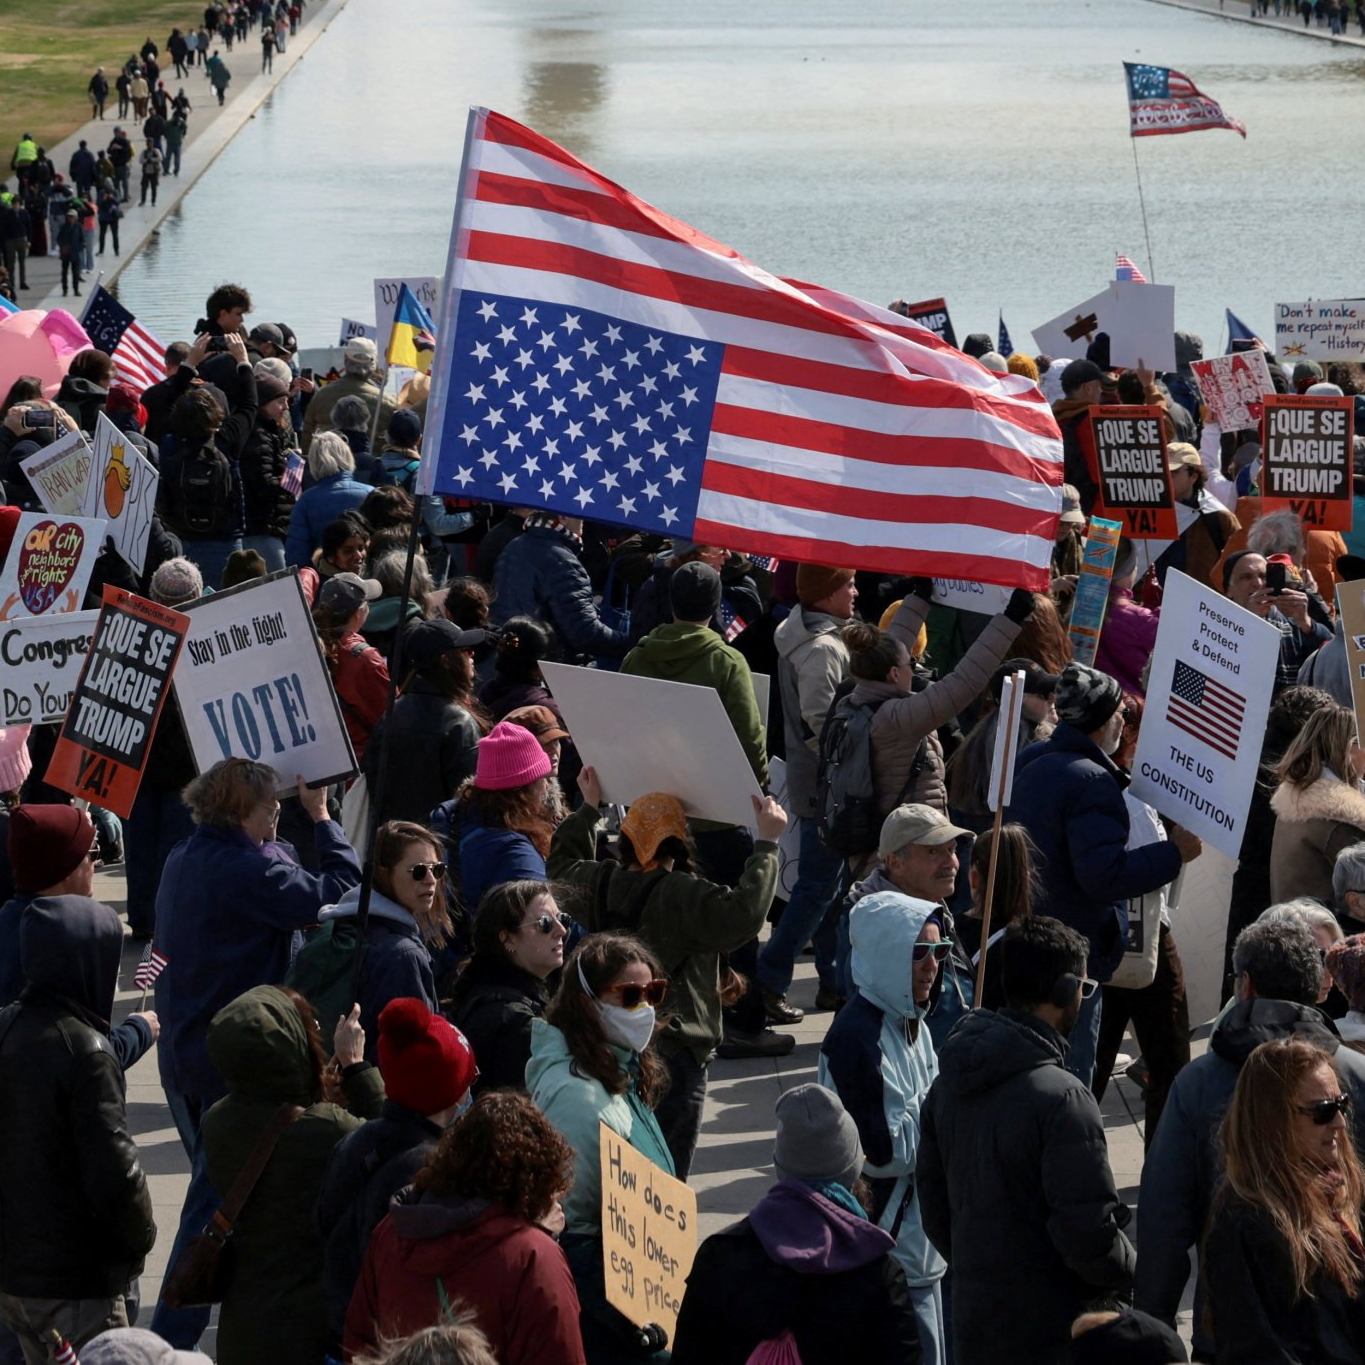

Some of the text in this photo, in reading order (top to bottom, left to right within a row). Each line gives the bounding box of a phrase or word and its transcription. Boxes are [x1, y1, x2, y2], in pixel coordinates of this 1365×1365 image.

[1319, 304, 1357, 318] make
[348, 323, 365, 337] NO
[1276, 323, 1294, 333] me
[1297, 320, 1332, 340] repeat
[1097, 420, 1160, 447] ¡QUE SE
[1270, 409, 1346, 436] ¡QUE SE
[1100, 449, 1163, 474] LARGUE
[1268, 438, 1345, 465] LARGUE
[1105, 478, 1165, 502] TRUMP
[1270, 467, 1343, 494] TRUMP
[1126, 509, 1158, 533] YA!
[56, 526, 83, 556] city
[28, 551, 76, 575] neighbors
[32, 566, 66, 588] rights
[25, 587, 56, 613] USA
[1198, 601, 1245, 636] Preserve
[97, 612, 176, 672] ¡QUE SE
[187, 611, 288, 667] Stay in the fight!
[1200, 622, 1238, 654] Protect
[1191, 639, 1241, 675] & Defend
[85, 653, 161, 715] LARGUE
[4, 688, 32, 718] Do
[202, 671, 317, 762] VOTE!
[74, 696, 145, 755] TRUMP
[75, 749, 118, 799] YA!
[1169, 745, 1215, 784] THE US
[1141, 762, 1235, 832] CONSTITUTION
[608, 1139, 687, 1231] How does
[607, 1191, 679, 1278] this lower
[610, 1250, 635, 1299] egg
